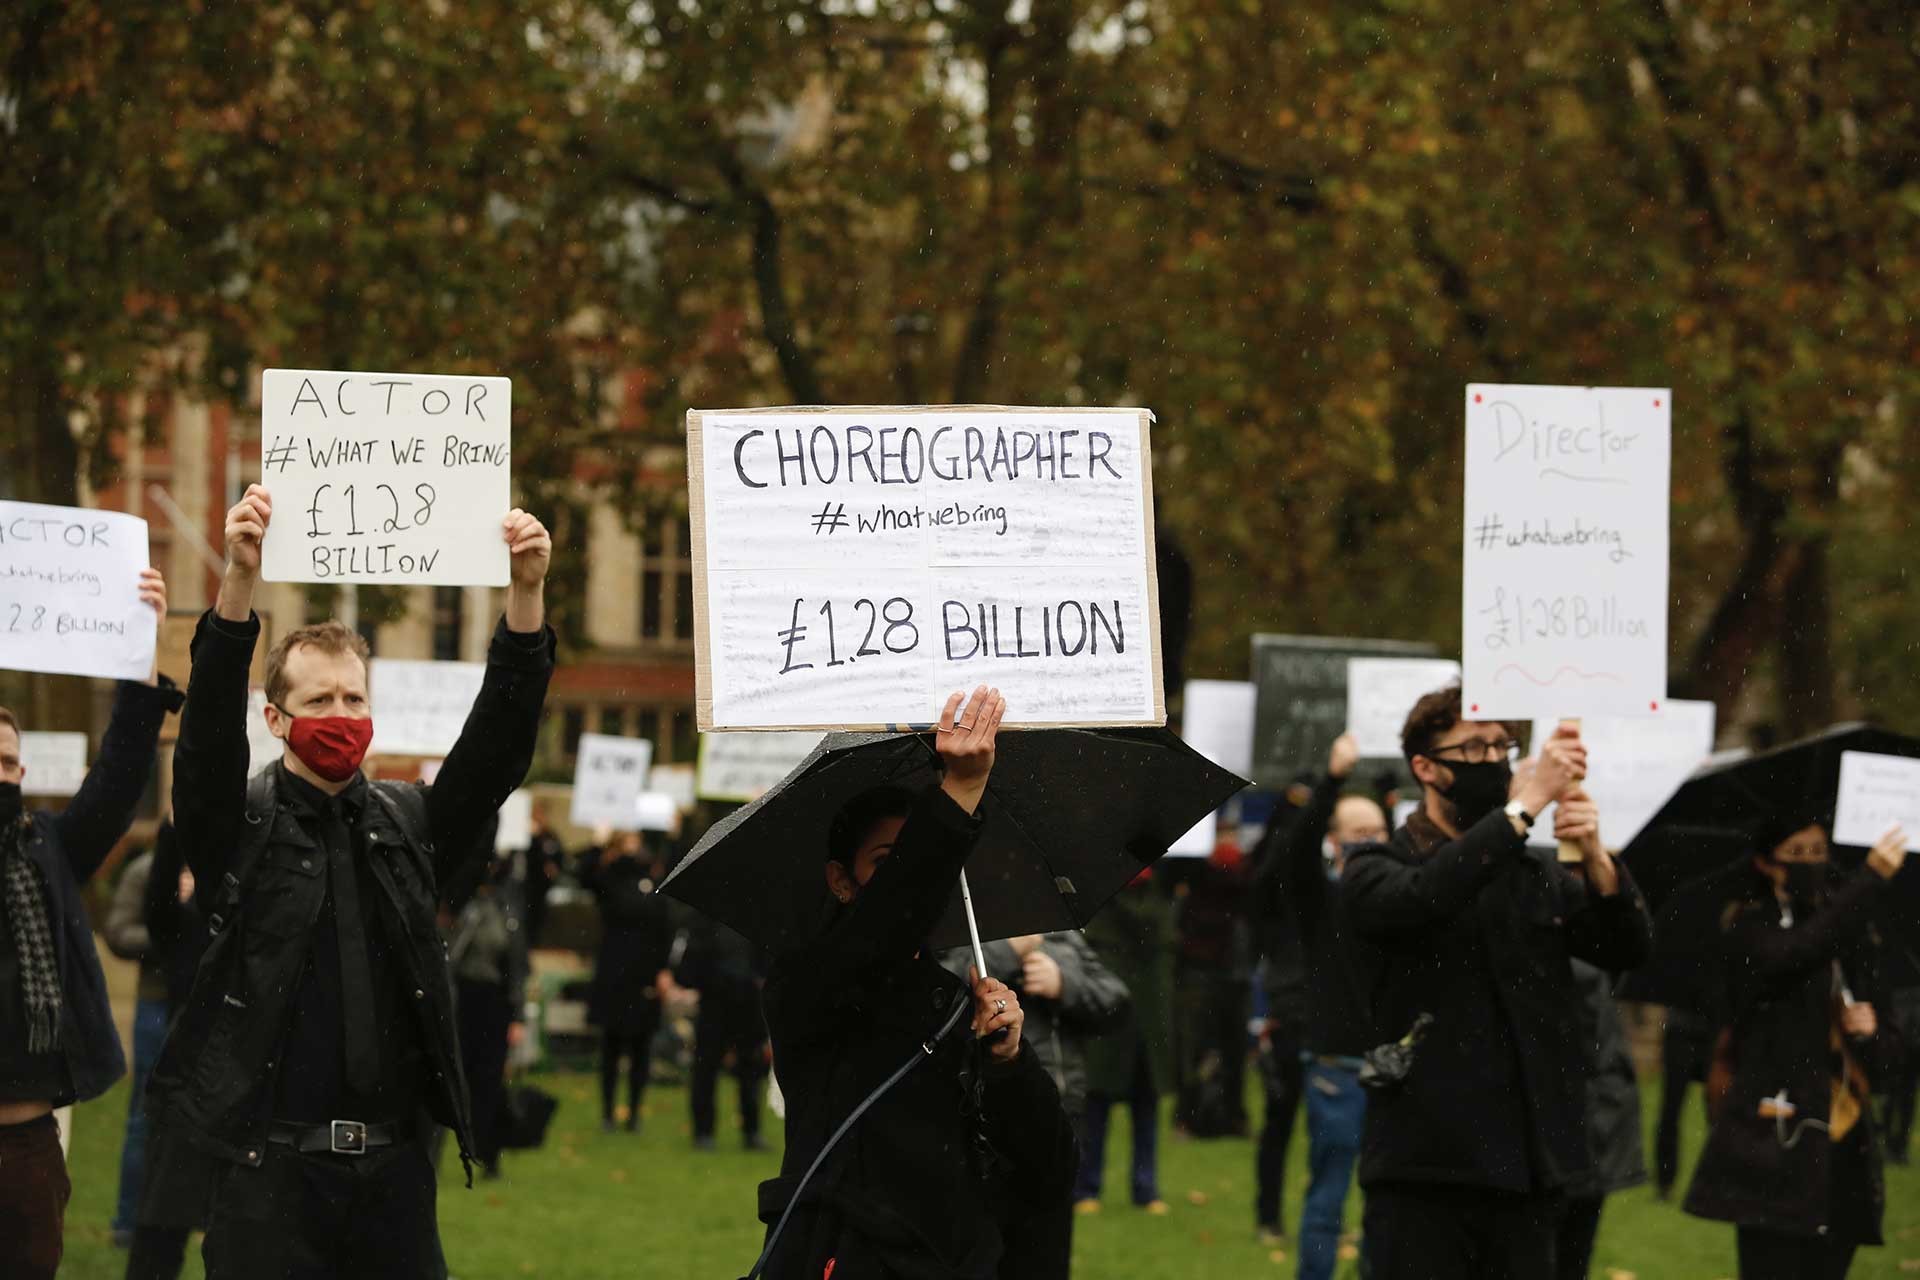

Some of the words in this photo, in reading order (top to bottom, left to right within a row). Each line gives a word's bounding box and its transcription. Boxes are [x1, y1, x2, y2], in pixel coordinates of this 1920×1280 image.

[290, 378, 487, 422] ACTOR
[391, 439, 425, 464] WE
[1488, 399, 1639, 463] Director
[733, 425, 1123, 488] CHOREOGRAPHER
[306, 483, 437, 538] £1.28
[809, 501, 1008, 536] #whatwebring
[312, 543, 439, 577] BILLION
[56, 611, 126, 636] BILLION
[777, 598, 919, 675] £1.28
[943, 599, 1126, 661] BILLION
